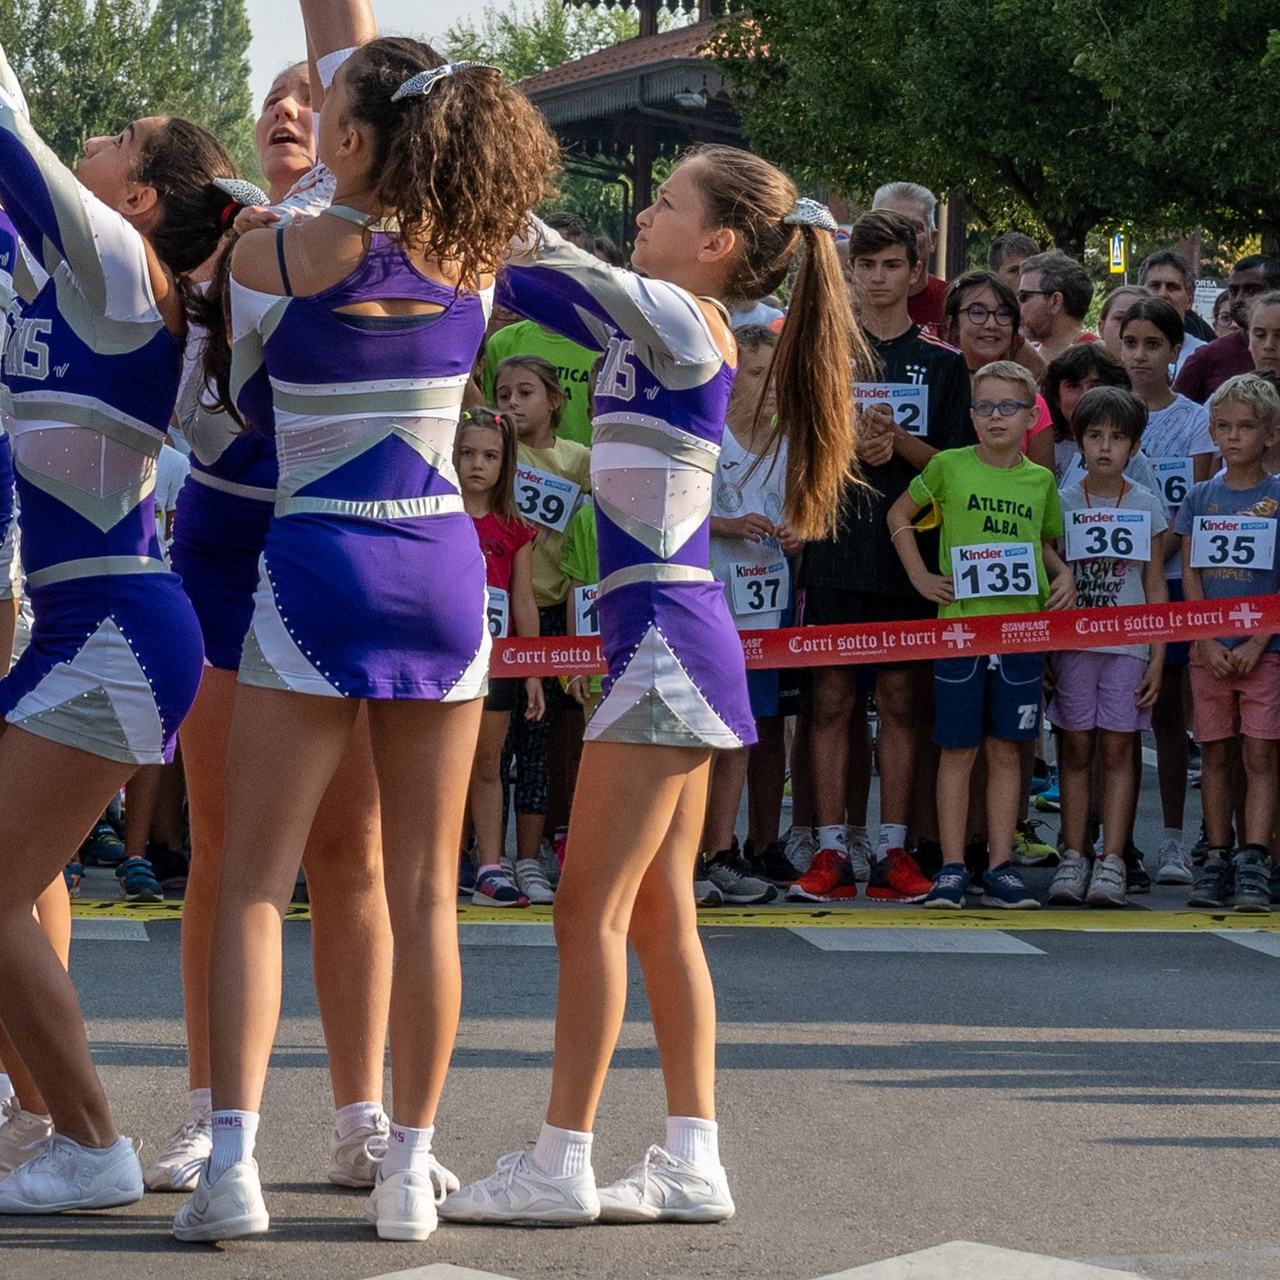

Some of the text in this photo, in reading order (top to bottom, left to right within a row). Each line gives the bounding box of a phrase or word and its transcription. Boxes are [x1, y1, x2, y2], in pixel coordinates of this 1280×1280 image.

[518, 484, 565, 525] 39
[1072, 512, 1115, 525] Kinder
[1200, 517, 1239, 531] Kinder
[1085, 526, 1134, 555] 36
[1208, 534, 1256, 565] 35
[959, 548, 1003, 562] Kinder
[736, 564, 767, 578] Kinder
[961, 562, 1032, 595] 135
[746, 578, 781, 611] 37
[1075, 615, 1120, 634] Corri
[1124, 615, 1165, 632] sotto
[1169, 611, 1183, 628] le
[1187, 607, 1224, 627] torri
[788, 634, 833, 653] Corri
[837, 635, 877, 651] sotto
[882, 631, 897, 648] le
[900, 627, 937, 646] torri
[502, 646, 546, 664] Corri
[551, 647, 591, 663] sotto
